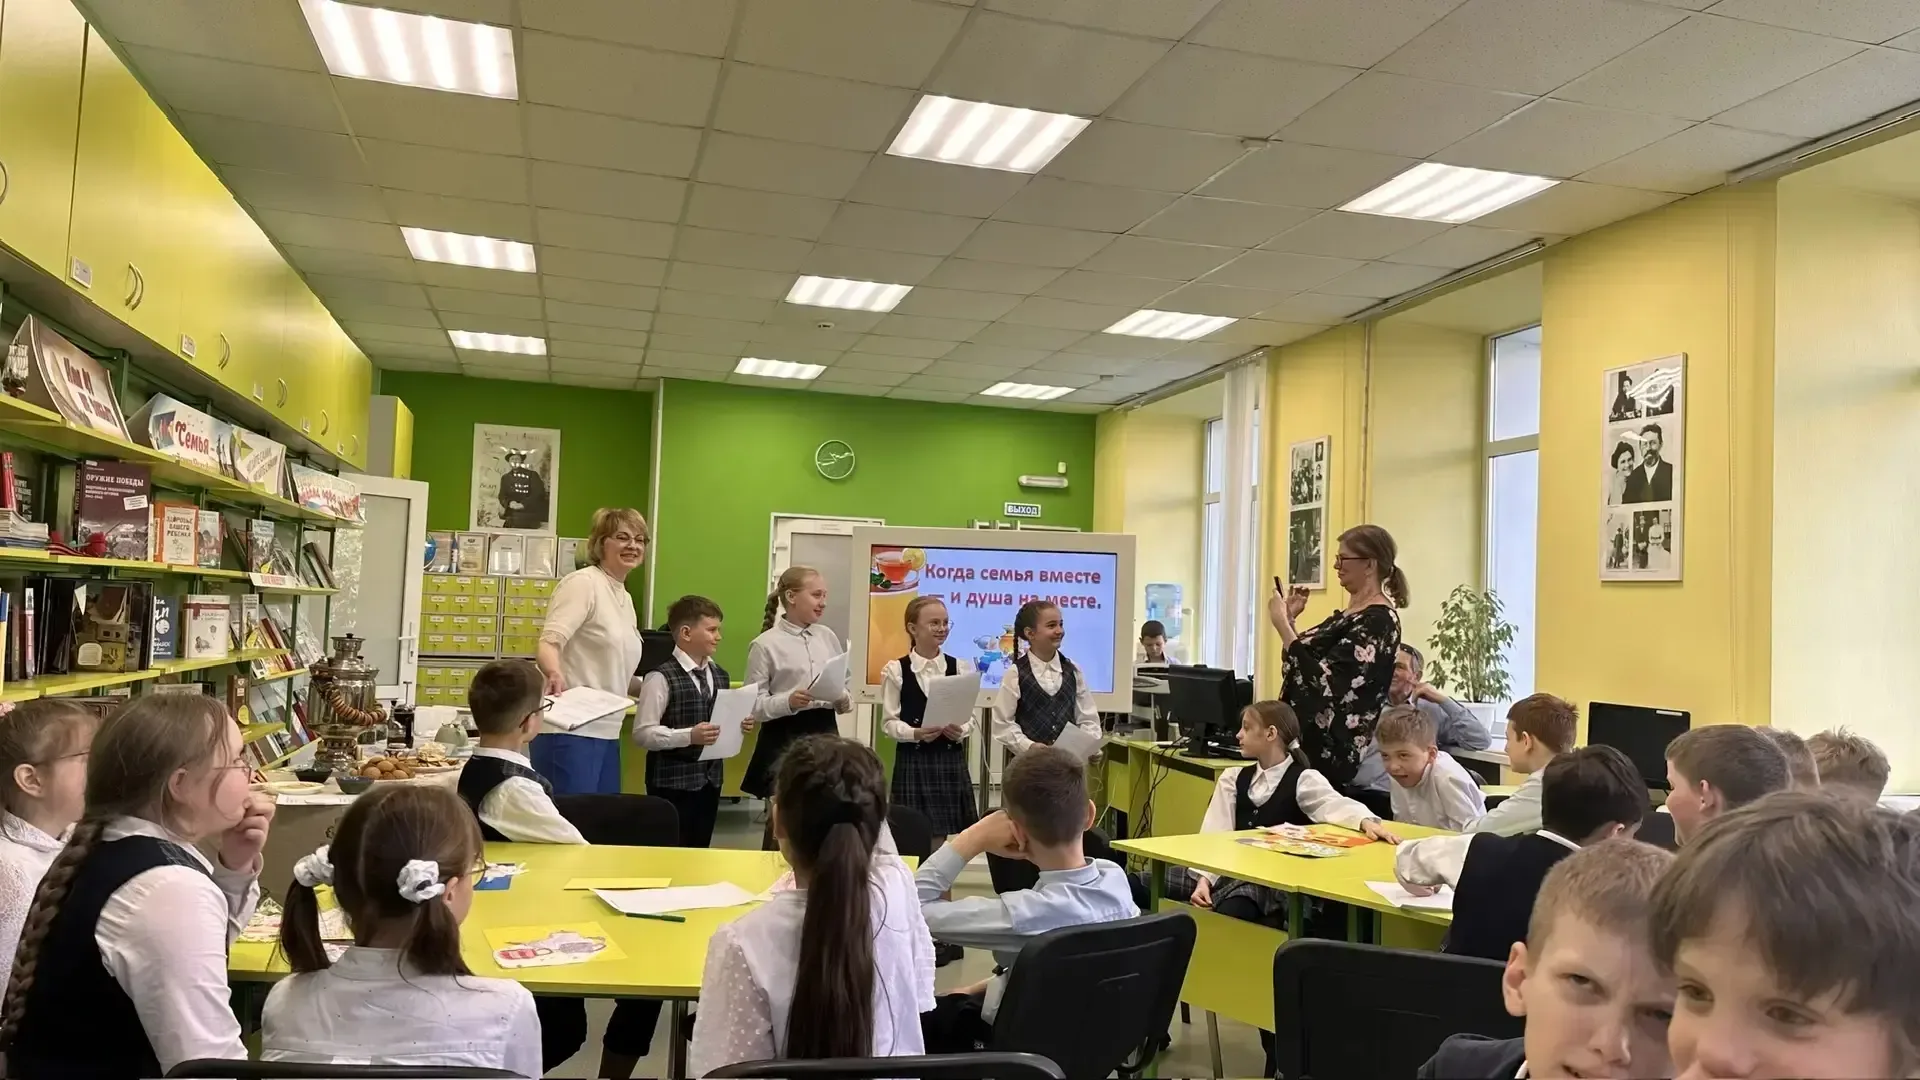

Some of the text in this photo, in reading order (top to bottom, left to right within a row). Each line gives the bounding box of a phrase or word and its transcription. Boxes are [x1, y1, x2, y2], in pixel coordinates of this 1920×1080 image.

[175, 420, 209, 455] Семья
[86, 474, 144, 487] ОРУЖИЕ ПОБЕДЫ
[1007, 505, 1038, 515] ВЫХОД
[925, 563, 1102, 584] Когда семья вместе
[951, 592, 961, 604] и
[966, 592, 1013, 609] душа
[1045, 594, 1101, 610] месте.
